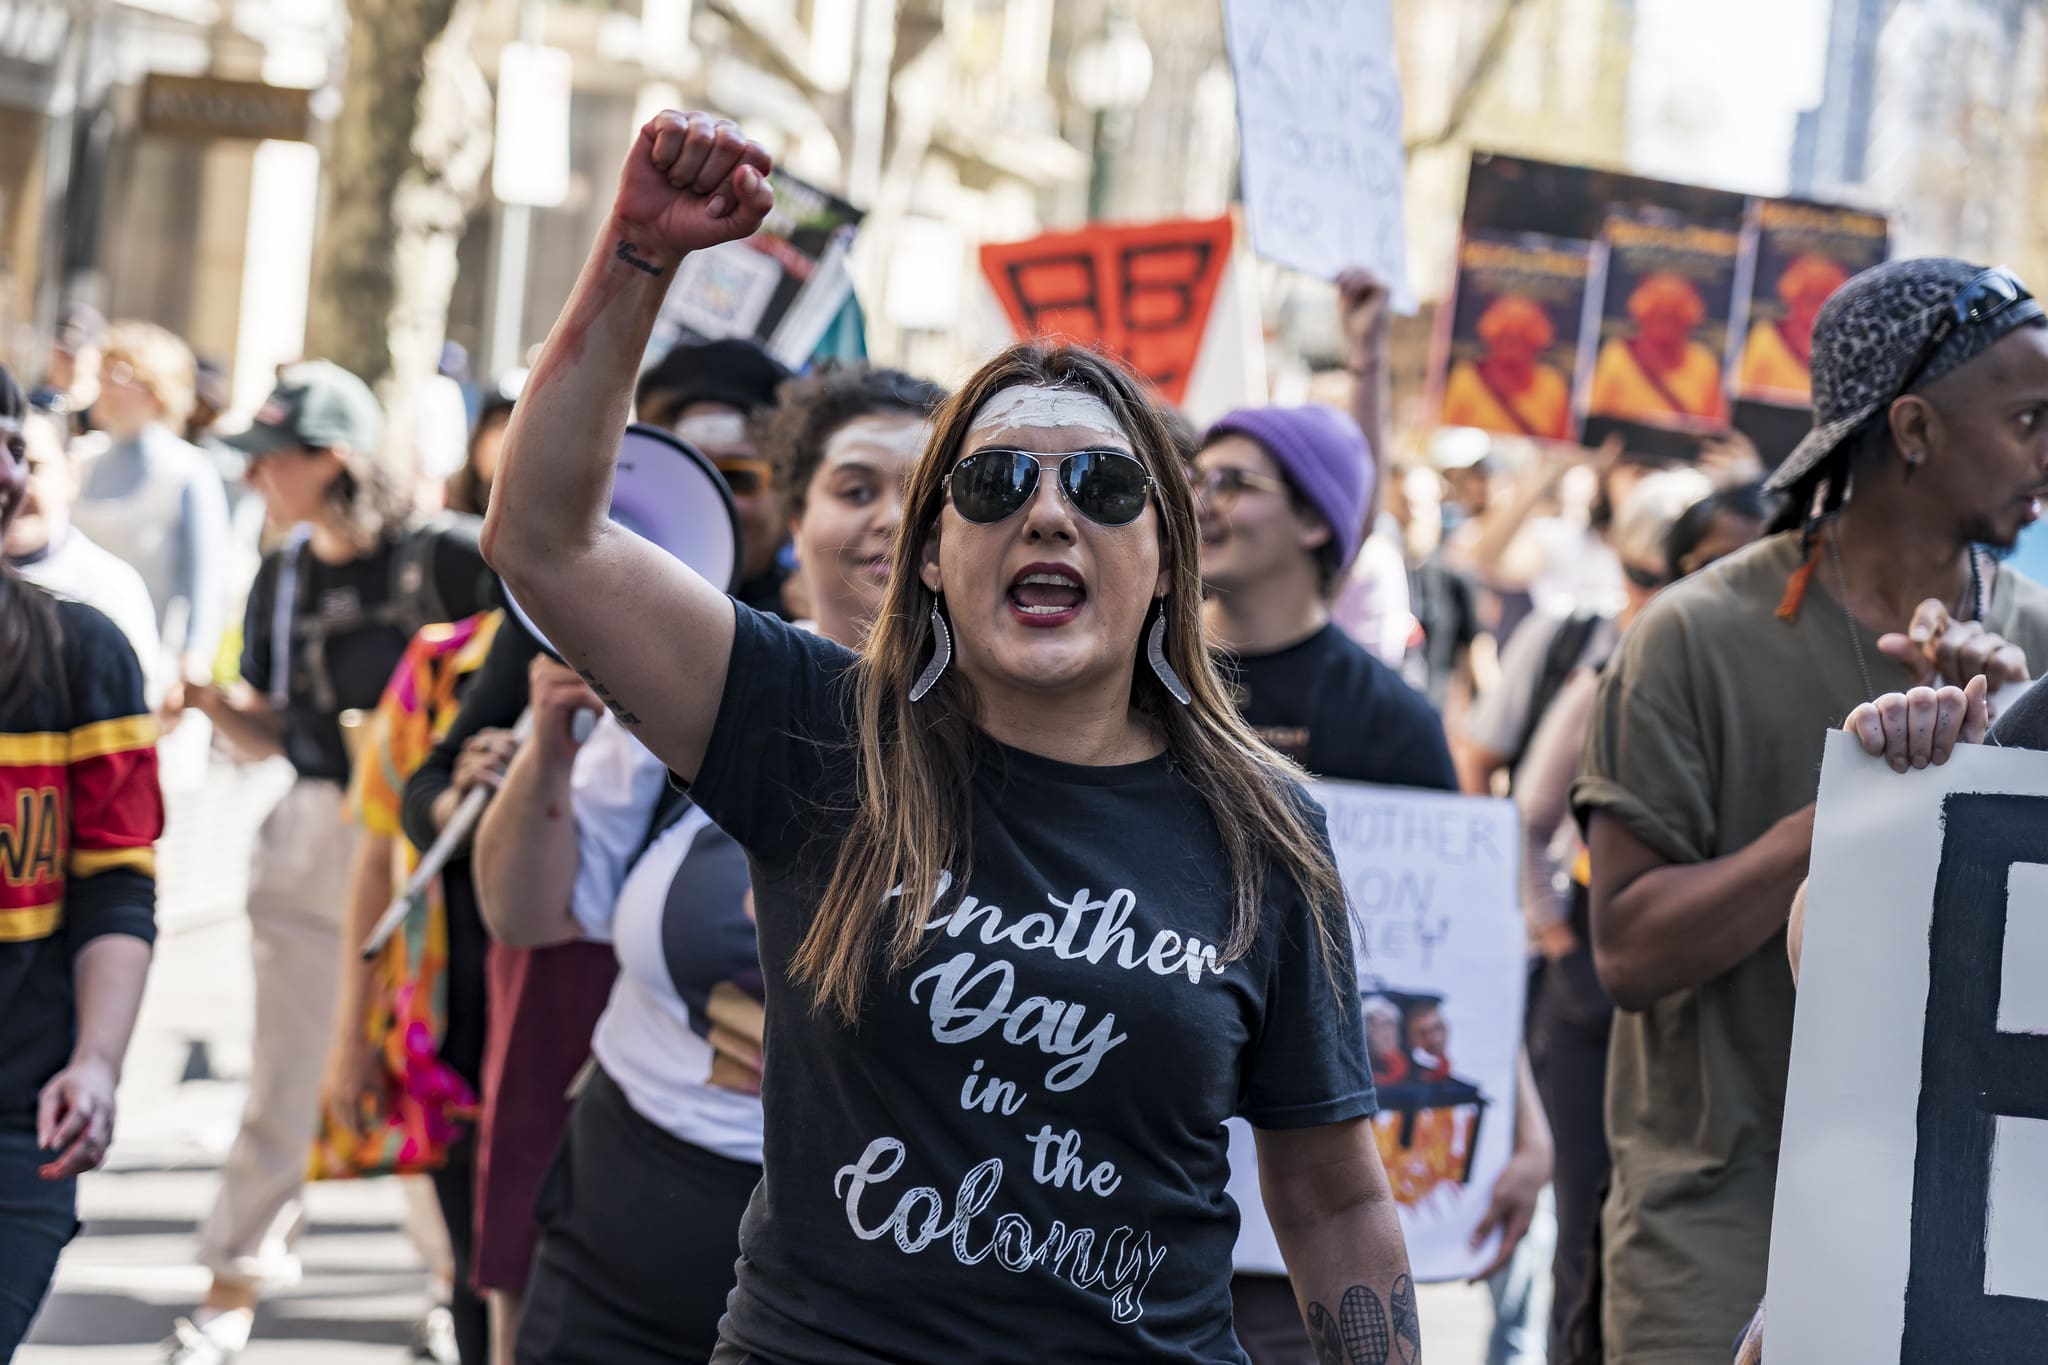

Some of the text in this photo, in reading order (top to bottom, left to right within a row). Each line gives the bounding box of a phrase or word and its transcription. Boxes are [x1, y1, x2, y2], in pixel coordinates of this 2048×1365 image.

[910, 952, 1127, 1093] Day
[960, 1058, 1028, 1116] in
[1025, 1124, 1122, 1198] the
[834, 1136, 1168, 1324] Colony
